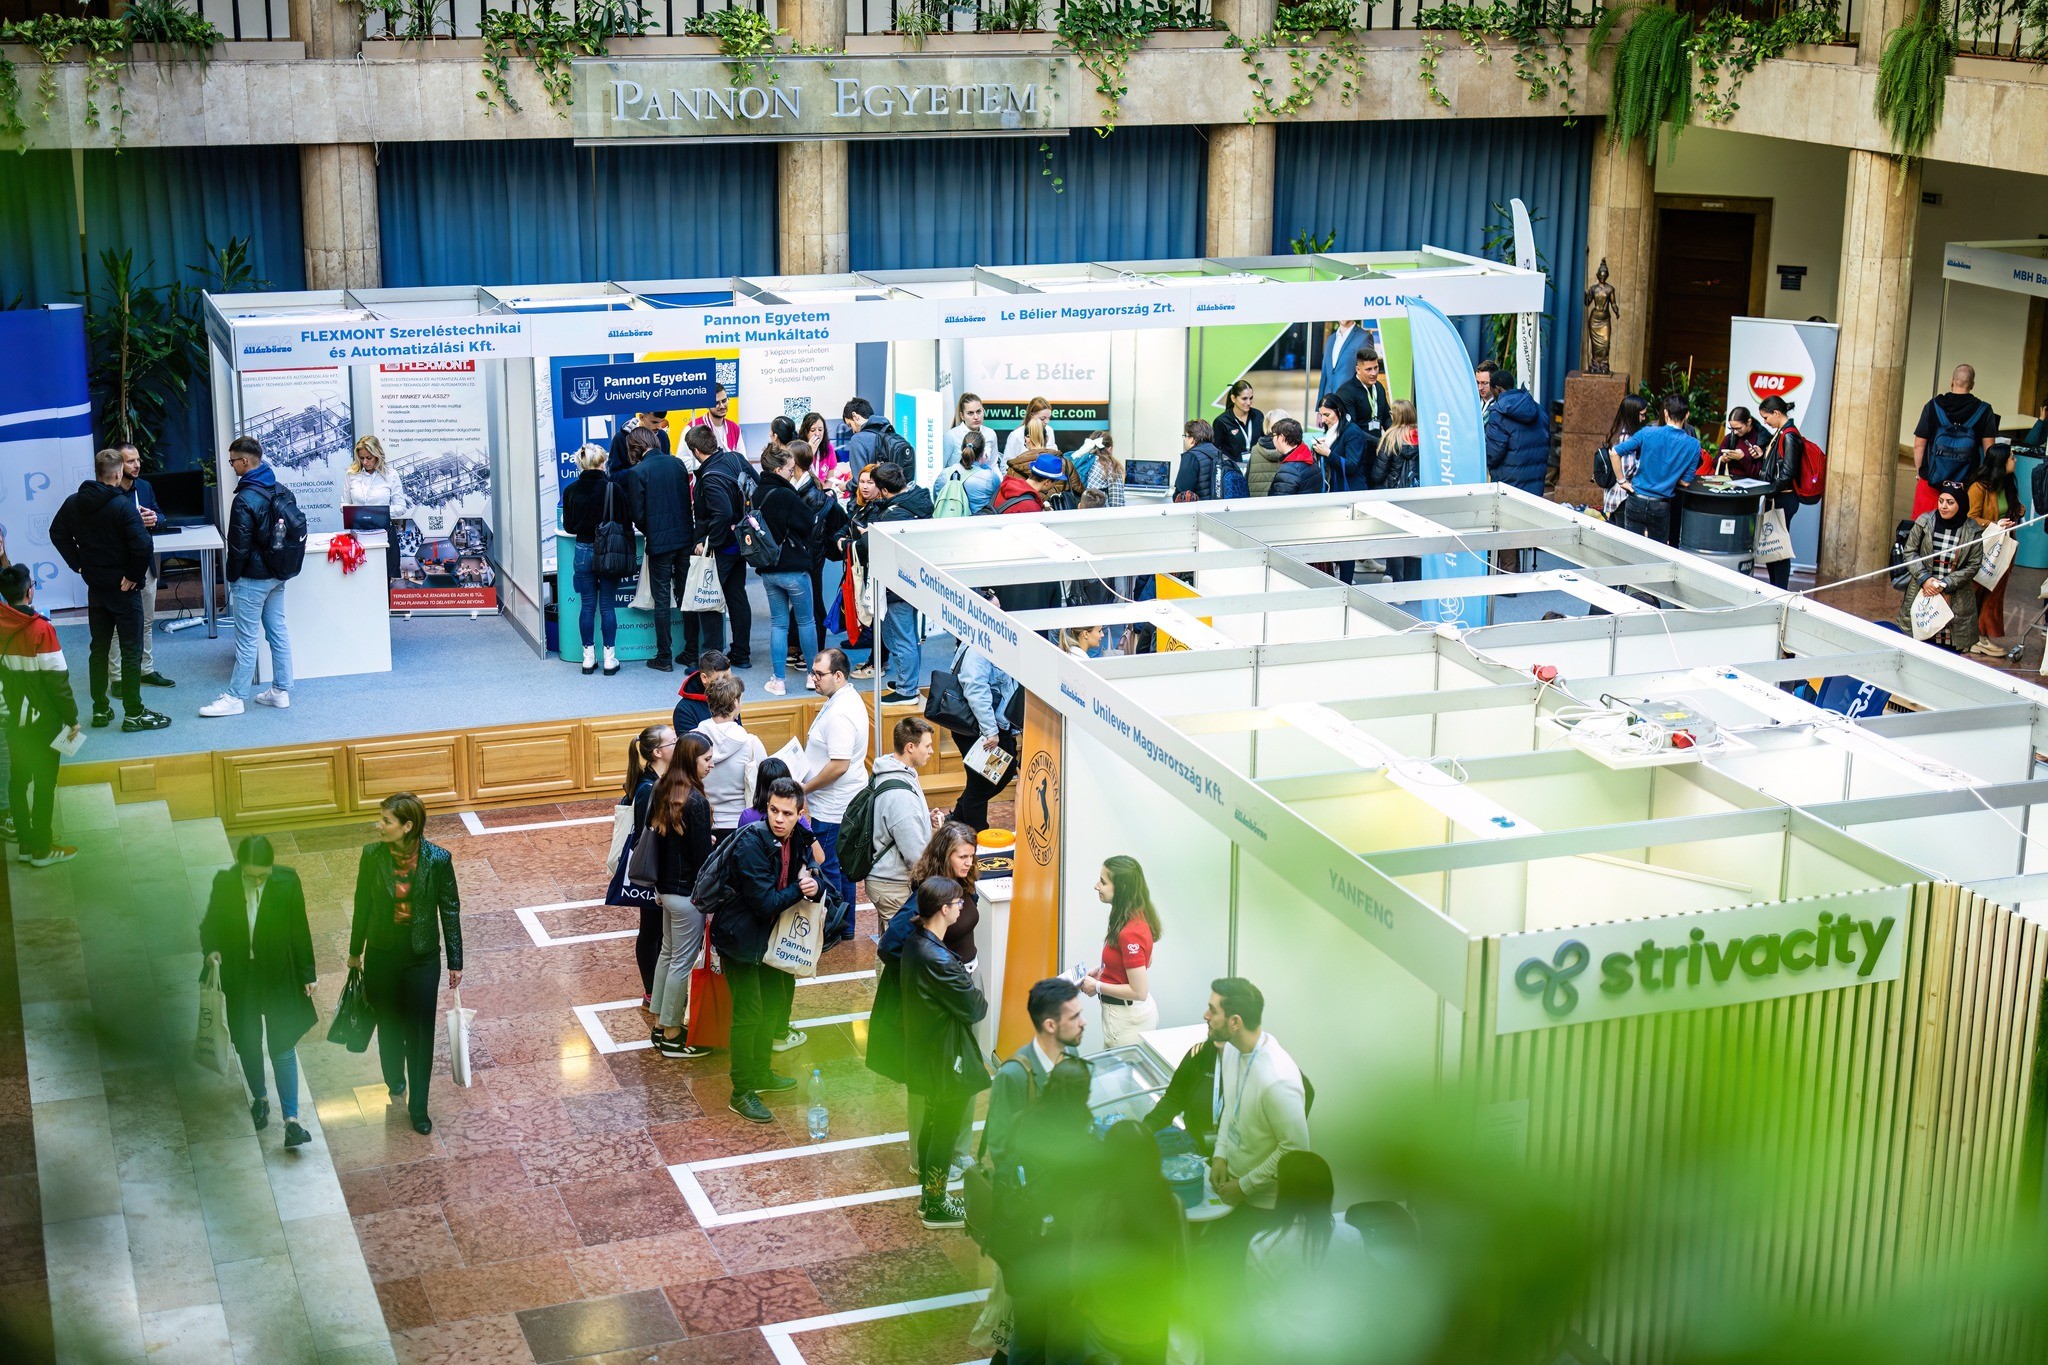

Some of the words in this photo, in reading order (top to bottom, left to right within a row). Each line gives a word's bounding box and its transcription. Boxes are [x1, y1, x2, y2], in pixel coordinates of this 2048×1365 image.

[610, 79, 800, 121] PANNON
[830, 78, 1038, 117] EGYETEM
[2013, 269, 2034, 282] MBH
[2036, 273, 2048, 285] Ba
[1364, 296, 1391, 306] MOL
[704, 313, 760, 326] Pannon
[765, 311, 830, 326] Egyetem
[1001, 311, 1015, 321] Le
[1019, 308, 1057, 320] Bélier
[1061, 304, 1149, 319] Magyarország
[1153, 302, 1175, 313] Zrt.
[300, 327, 385, 342] FLEXMONT
[389, 321, 521, 339] Szereléstechnikai
[705, 331, 740, 343] mint
[745, 327, 829, 342] Munkáltató
[329, 346, 346, 359] és
[350, 340, 466, 358] Automatizálási
[469, 340, 496, 353] Kft.
[603, 374, 650, 387] Pannon
[653, 372, 707, 387] Egyetem
[1005, 363, 1030, 380] Le
[1036, 362, 1095, 380] Bélier
[1754, 375, 1785, 391] MOL
[604, 389, 651, 402] University
[653, 387, 663, 397] of
[664, 385, 707, 397] Pannonia
[984, 406, 1097, 419] www.leer.com
[1758, 538, 1781, 547] Pannon
[919, 567, 966, 612] Continental
[967, 599, 1018, 646] Automotive
[941, 604, 976, 644] Hungary
[977, 630, 994, 654] Kft.
[1092, 697, 1131, 739] Unilever
[1133, 730, 1202, 794] Magyarország
[1204, 776, 1224, 806] Kft.
[1328, 868, 1394, 930] YANFENG
[781, 937, 812, 955] Pannon
[1600, 910, 1896, 996] strivacity
[776, 947, 812, 967] Egyetem
